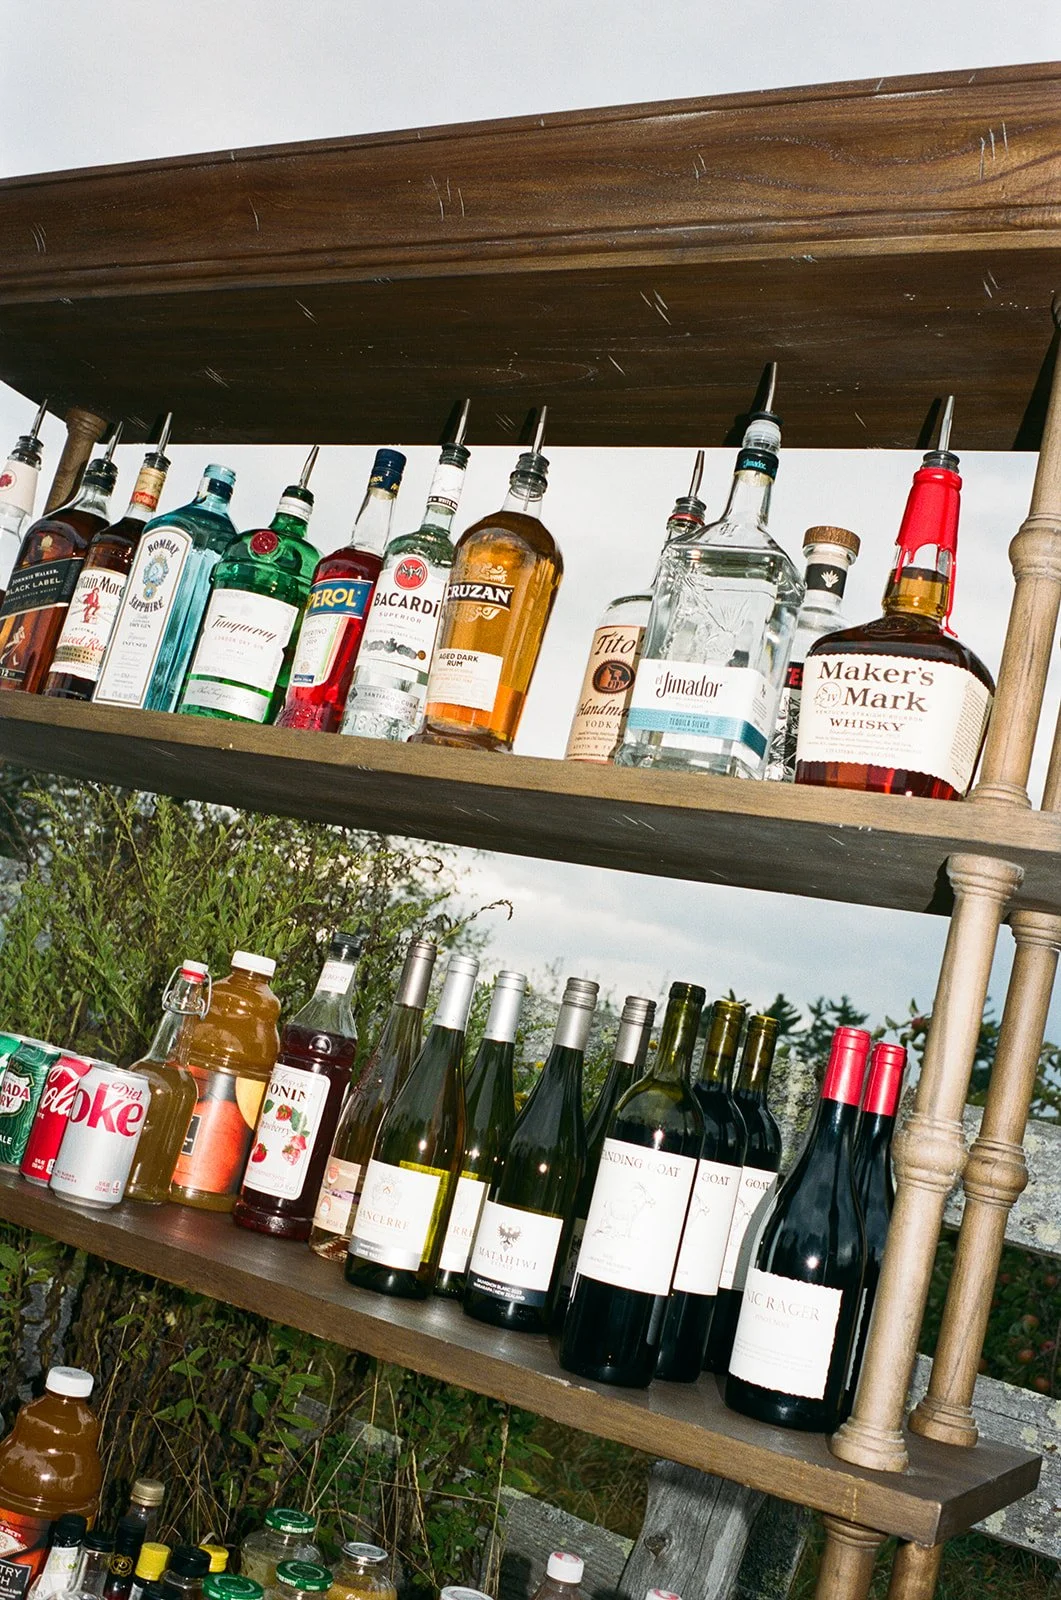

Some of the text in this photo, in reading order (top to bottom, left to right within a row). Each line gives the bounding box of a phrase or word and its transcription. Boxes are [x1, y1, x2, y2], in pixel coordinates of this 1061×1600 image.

[147, 538, 179, 556] BOMBAY
[32, 577, 62, 589] LABEL
[128, 595, 164, 614] SAPPHIRE
[378, 611, 423, 625] SUPERIOR
[211, 614, 277, 644] Tanqueray
[439, 653, 479, 663] AGED DARK
[446, 660, 464, 668] RUM
[817, 661, 935, 687] Maker's
[655, 671, 724, 699] Jimador
[842, 687, 929, 713] Mark
[830, 717, 906, 732] WHISKY
[111, 1081, 144, 1102] Diet
[701, 1172, 731, 1187] GOAT
